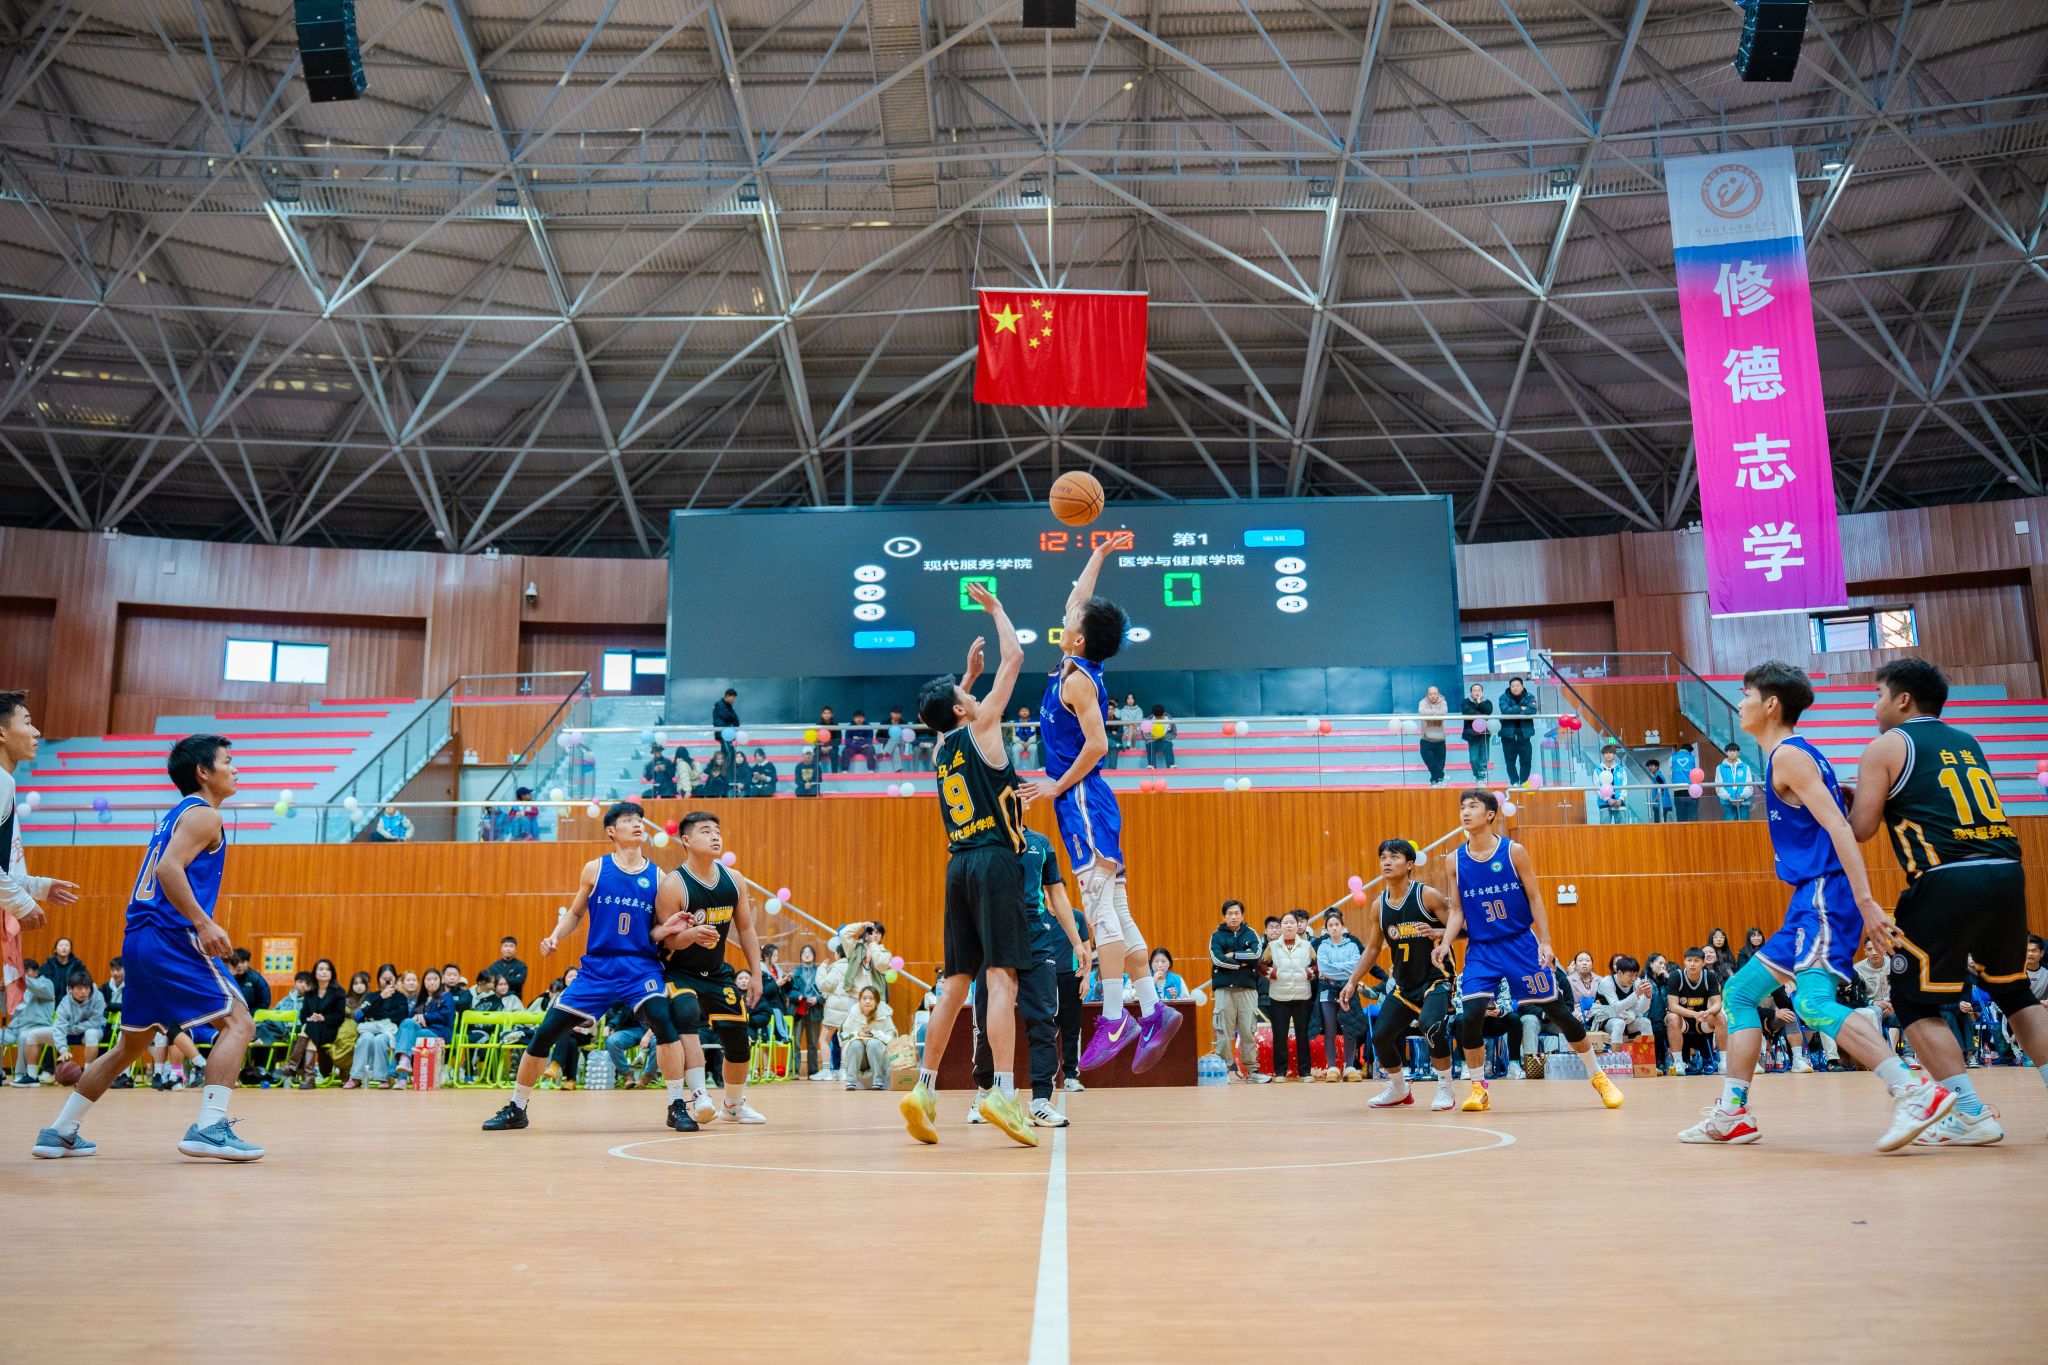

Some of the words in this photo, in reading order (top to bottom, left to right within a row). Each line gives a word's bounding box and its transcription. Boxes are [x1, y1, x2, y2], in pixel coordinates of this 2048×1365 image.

[1713, 259, 1805, 582] 修德志学
[1172, 532, 1209, 547] 第1
[923, 558, 1033, 571] 现代服务学院
[1118, 554, 1246, 568] 医学与健康学院
[863, 589, 878, 597] +2
[1163, 572, 1201, 607] 0
[1285, 581, 1300, 589] +2
[862, 608, 878, 616] +3
[1285, 600, 1301, 608] +3
[943, 772, 975, 826] 9
[1938, 767, 2006, 825] 10
[1482, 900, 1507, 922] 30
[618, 912, 631, 935] 0
[1398, 943, 1410, 962] 7
[644, 979, 658, 993] 0
[1522, 971, 1550, 994] 30
[723, 986, 737, 1005] 3
